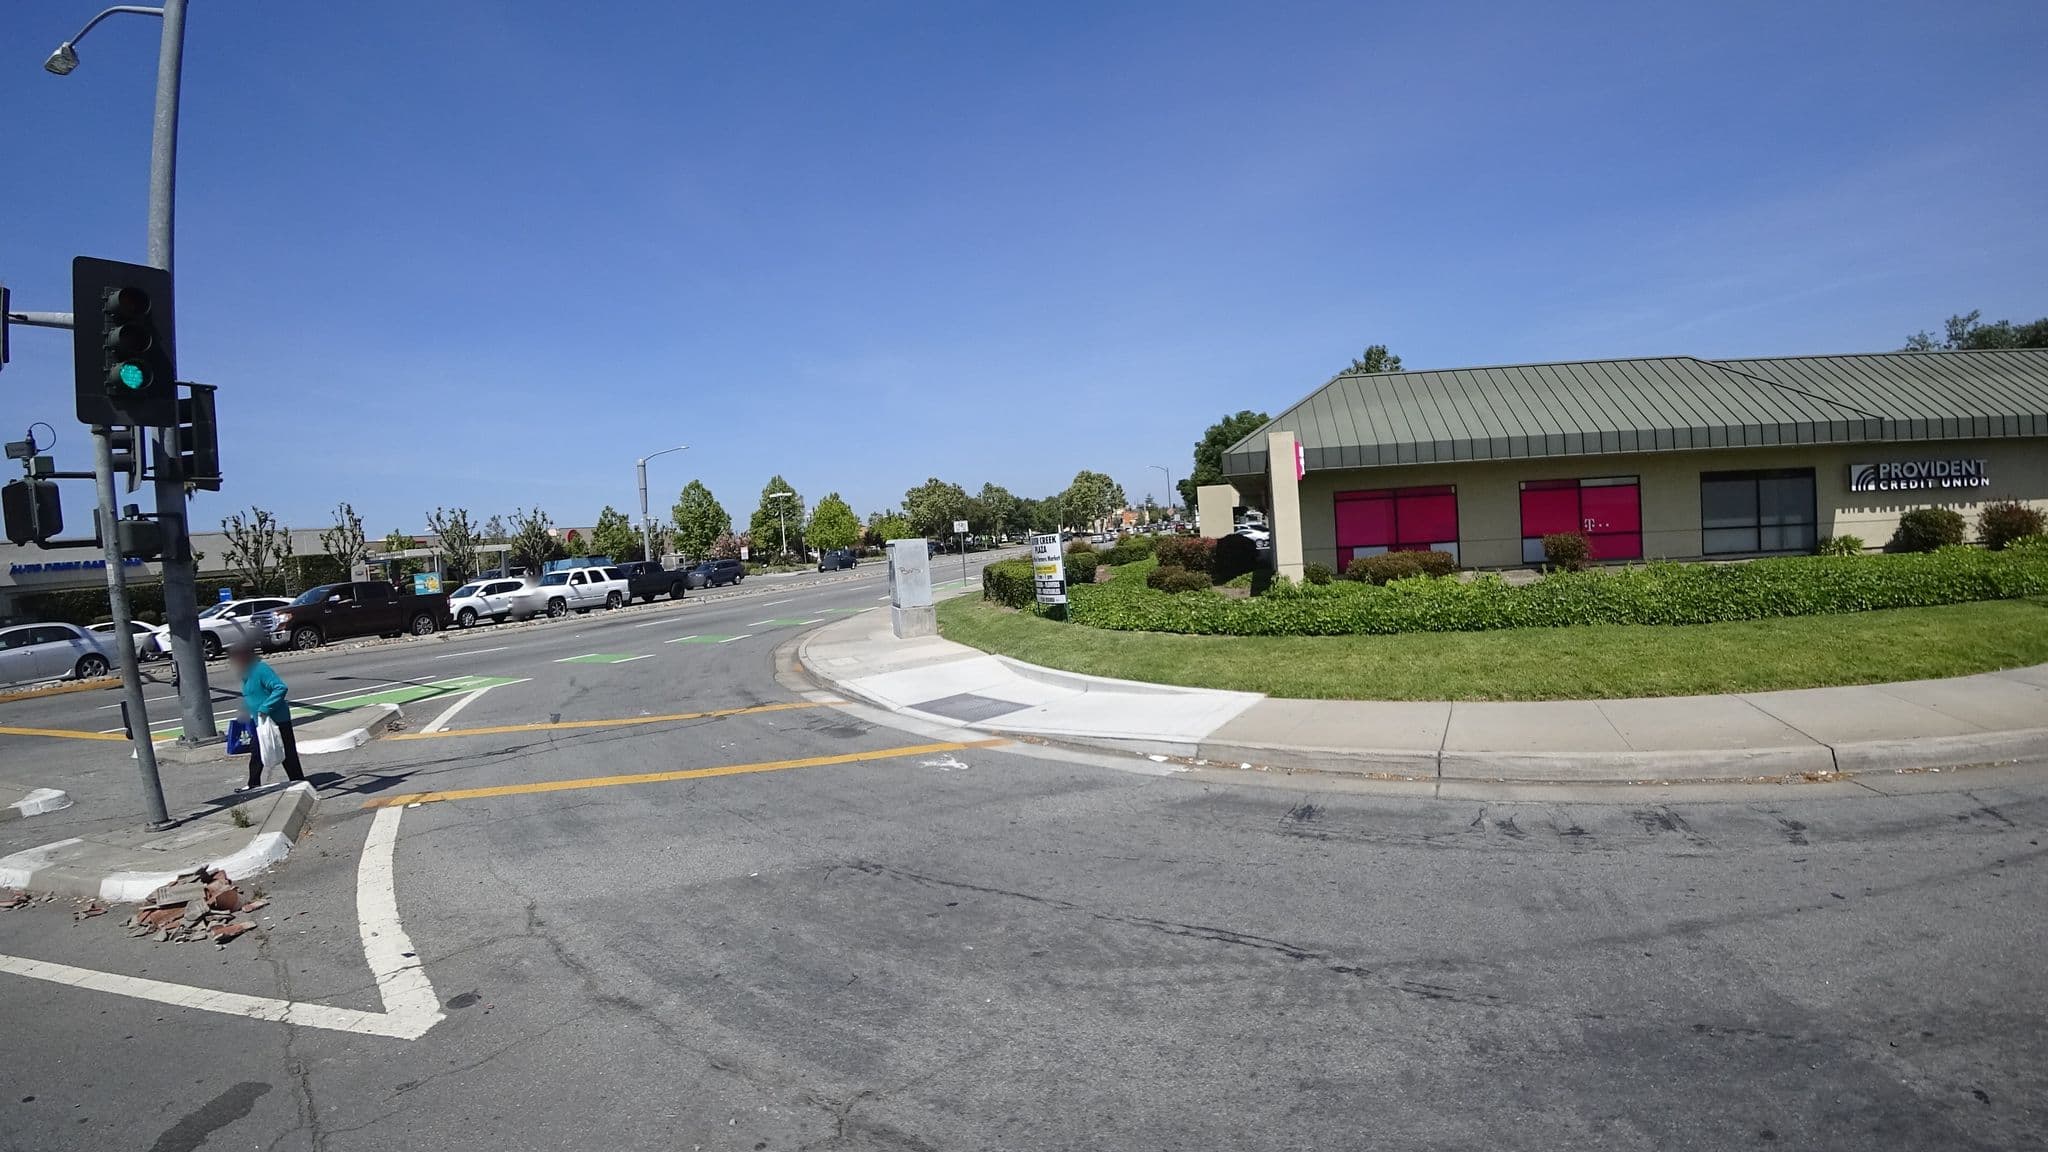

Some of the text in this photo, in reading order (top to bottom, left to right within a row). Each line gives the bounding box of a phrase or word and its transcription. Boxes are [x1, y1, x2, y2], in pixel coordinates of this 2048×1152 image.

[1880, 460, 1987, 478] PROVIDENT
[1880, 476, 1990, 491] CREDIT UNION
[1040, 535, 1057, 545] CREEK
